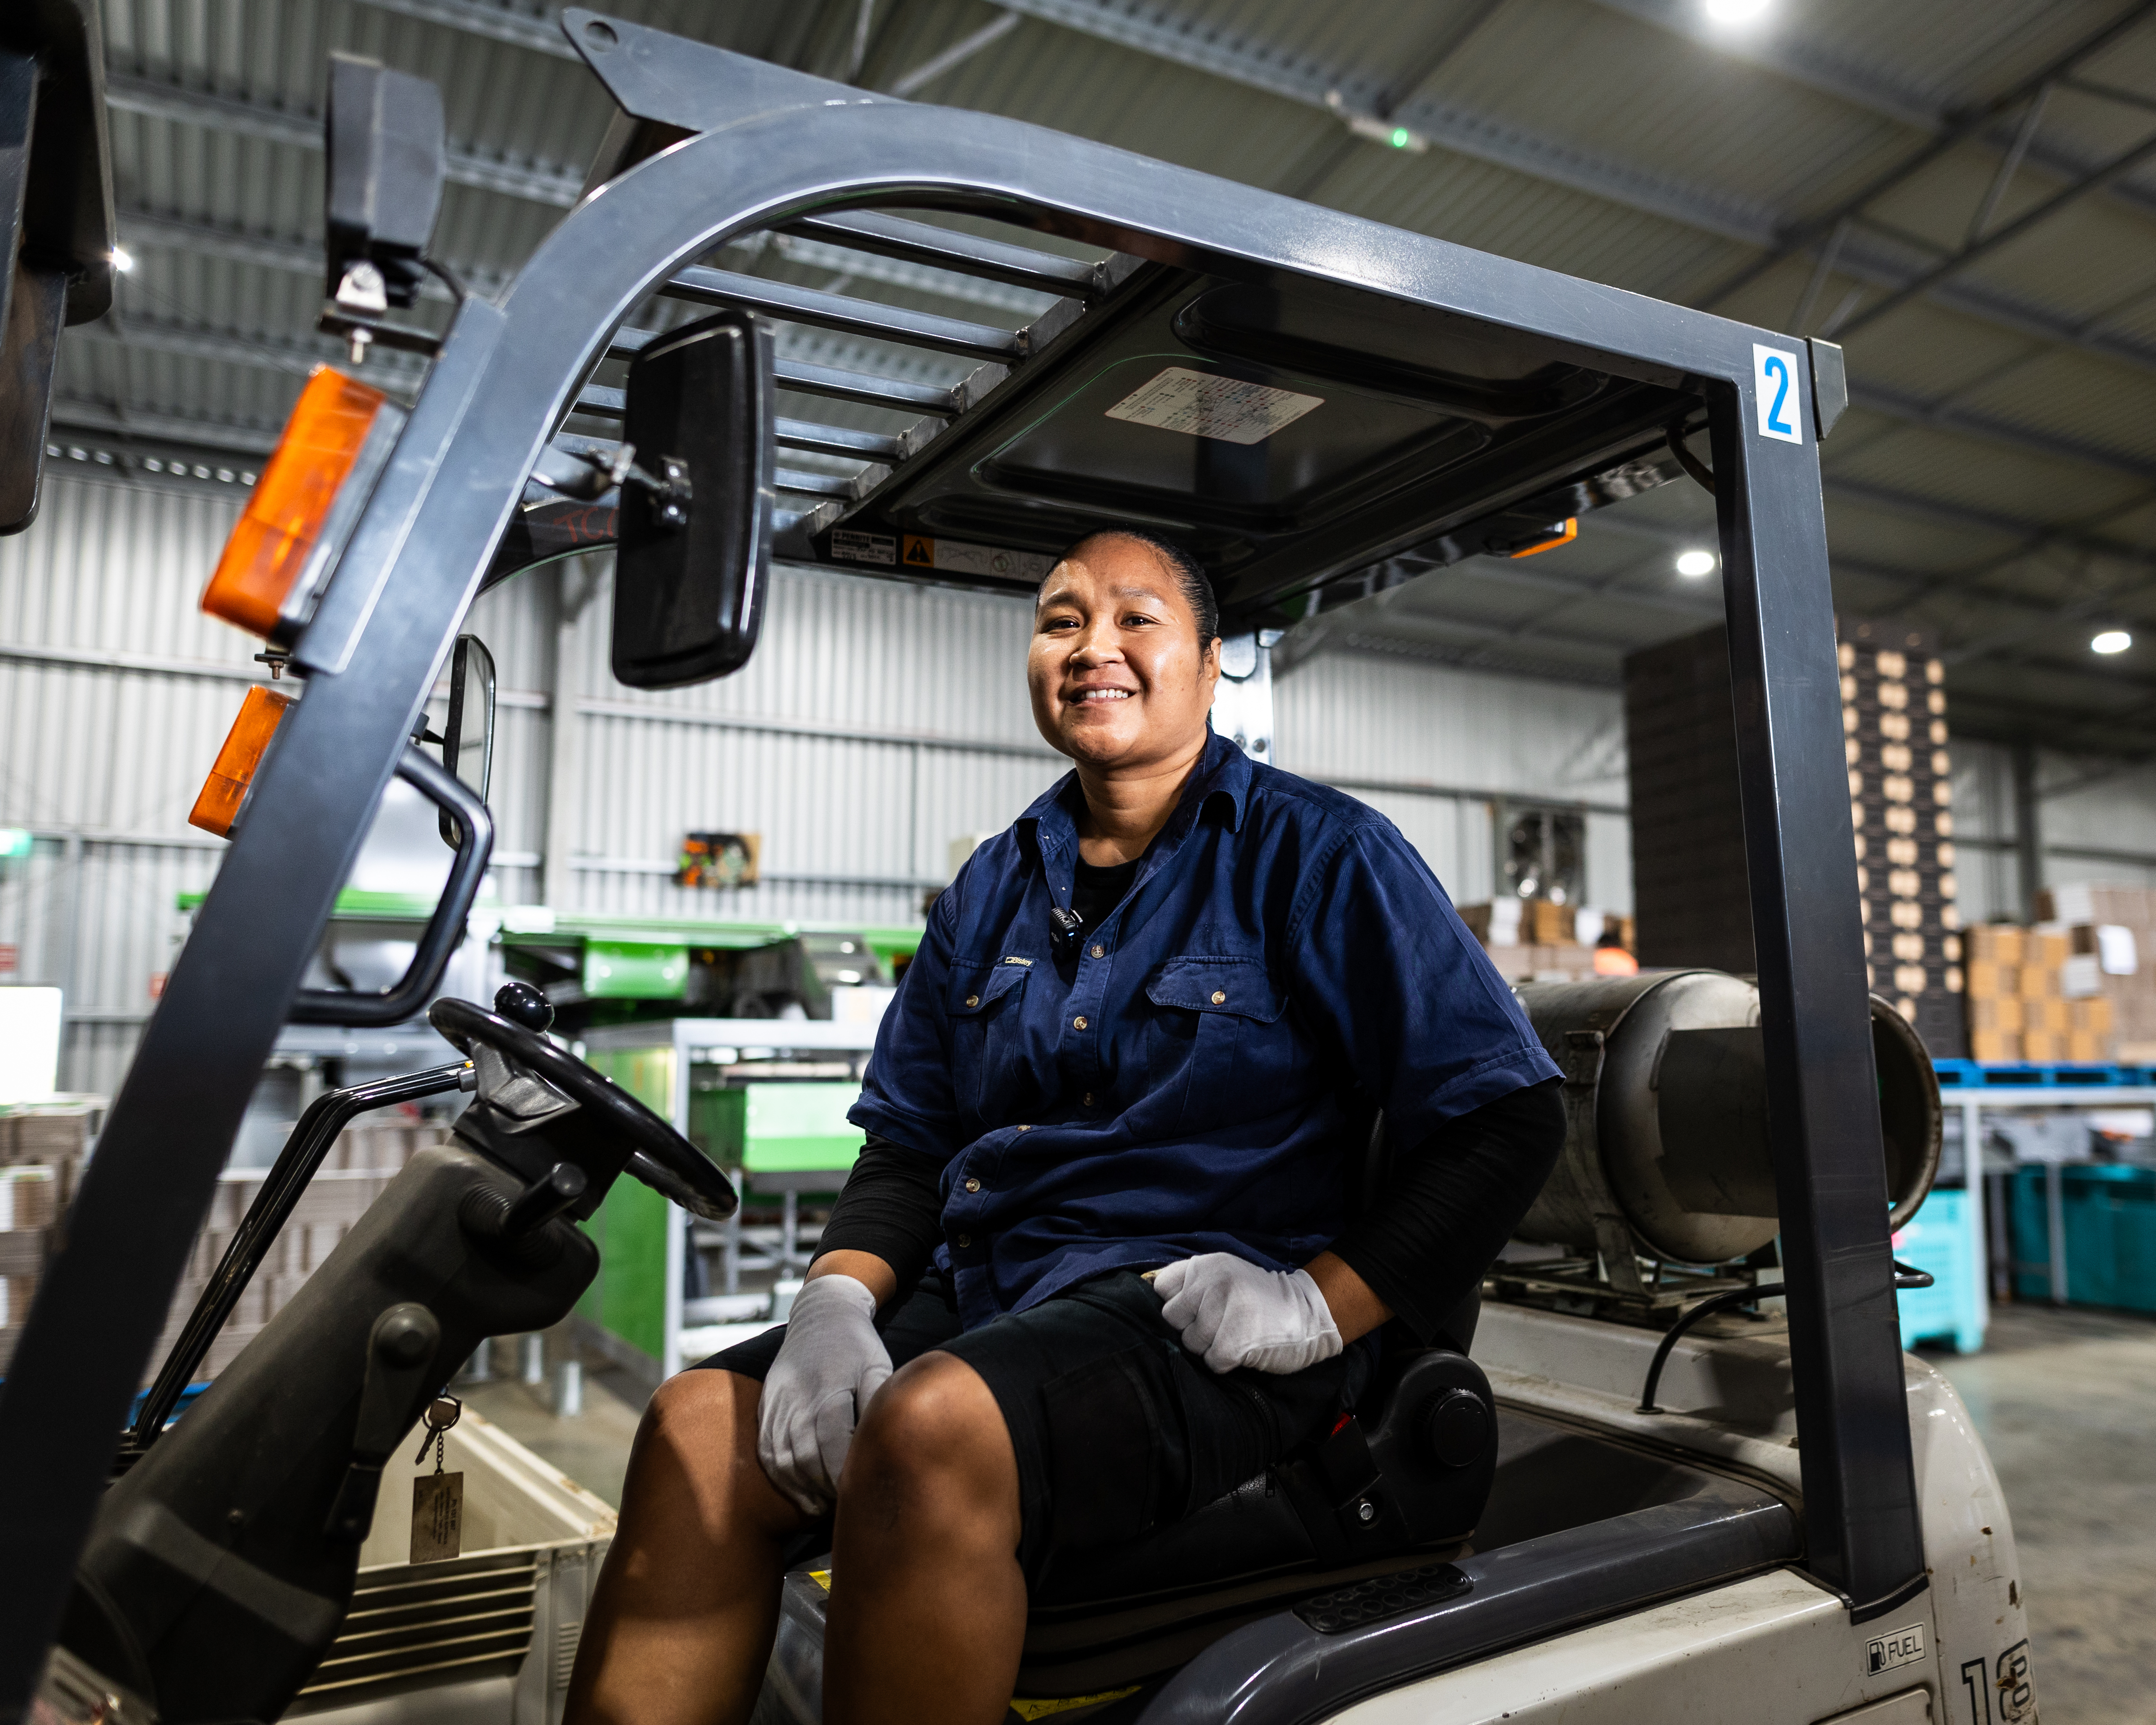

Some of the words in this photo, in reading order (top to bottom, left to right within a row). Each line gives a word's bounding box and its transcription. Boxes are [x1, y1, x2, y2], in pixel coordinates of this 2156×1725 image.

[1765, 356, 1792, 435] 2
[1012, 957, 1033, 966] Bisley
[1888, 1635, 1922, 1661] FUEL
